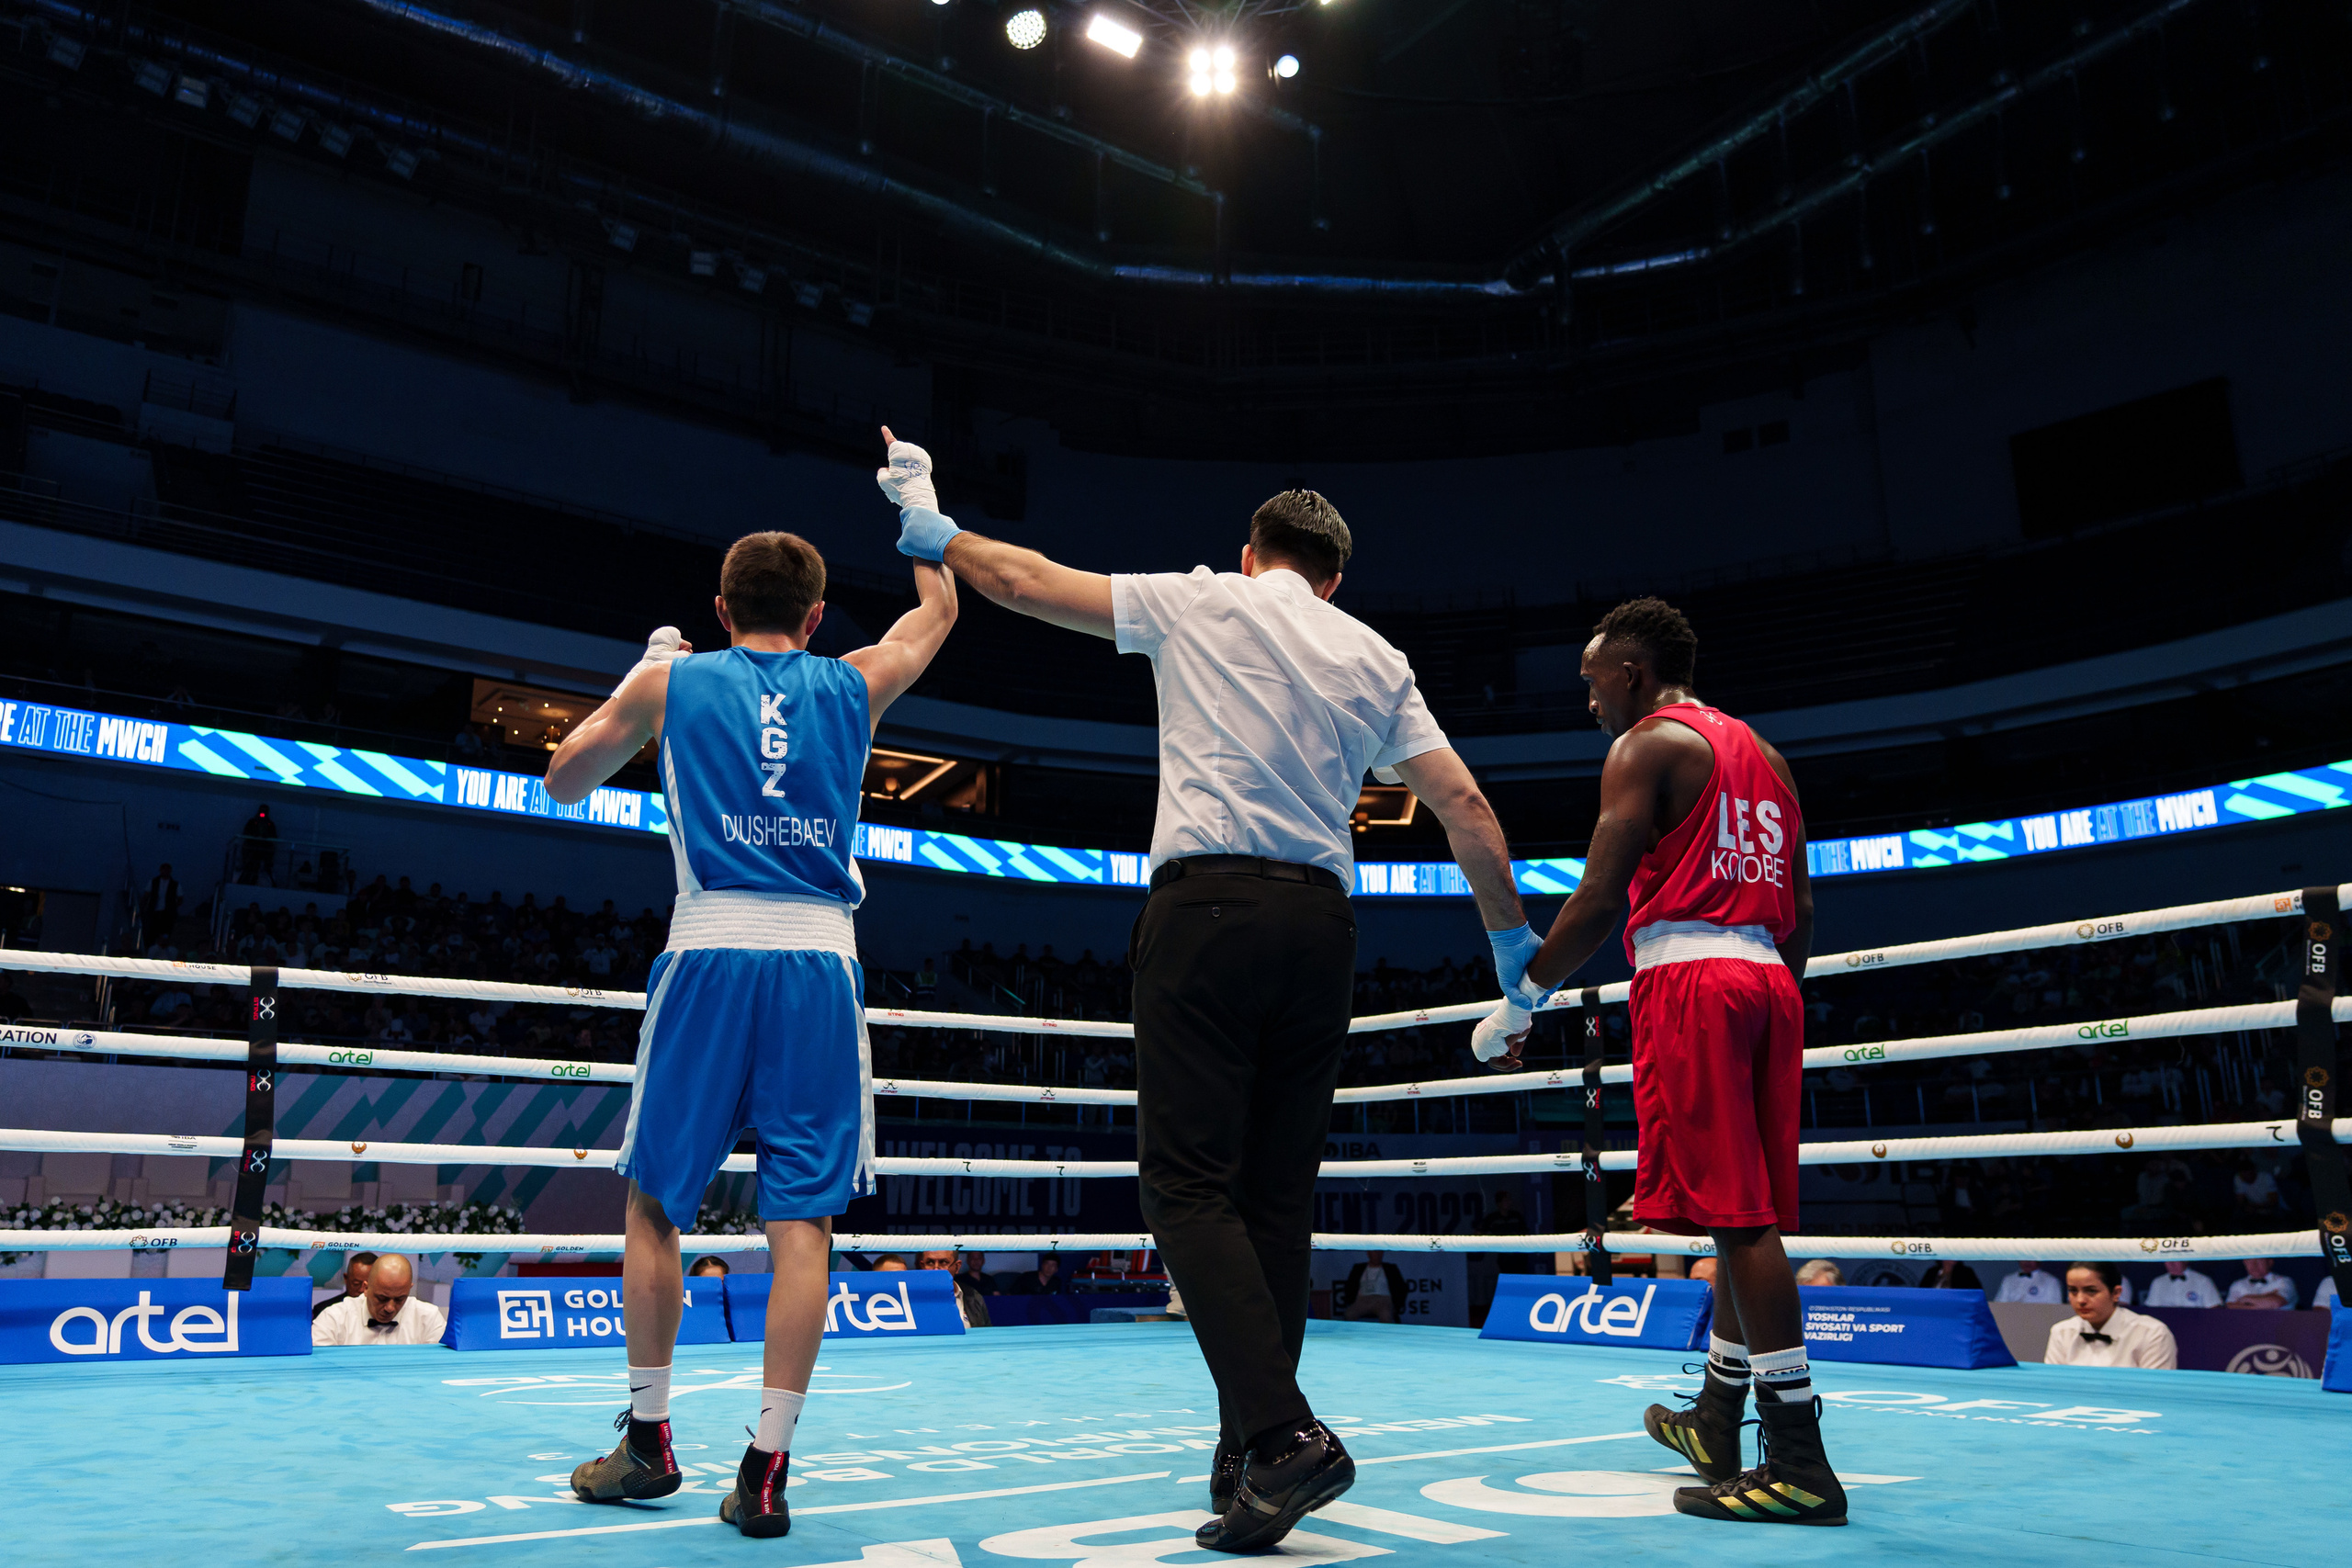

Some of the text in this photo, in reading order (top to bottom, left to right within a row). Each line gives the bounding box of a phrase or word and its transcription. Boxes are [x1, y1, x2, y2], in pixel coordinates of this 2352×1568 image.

[17, 705, 51, 747] AT
[53, 710, 96, 753] THE
[96, 716, 169, 764] MWCH
[760, 693, 788, 798] KGZ
[457, 768, 492, 807] YOU
[493, 774, 528, 812] ARE
[588, 787, 642, 828] MWCH
[1717, 791, 1784, 855] LES
[2020, 790, 2220, 852] YOU ARE AT THE MWCH
[868, 826, 913, 863] MWCH
[1819, 840, 1850, 874] THE
[1849, 835, 1905, 872] MWCH
[1109, 854, 1138, 885] YOU
[1359, 864, 1388, 894] YOU
[1390, 864, 1418, 894] ARE
[1419, 864, 1437, 894] AT
[1438, 864, 1466, 894] THE
[2098, 921, 2124, 934] OFB
[1862, 953, 1884, 964] OFB
[2311, 943, 2326, 974] OFB
[2077, 1020, 2130, 1041] artel
[329, 1050, 374, 1066] artel
[1844, 1043, 1886, 1063] artel
[551, 1063, 591, 1078] artel
[2308, 1089, 2324, 1120] OFB
[1341, 1142, 1382, 1158] IBA
[884, 1140, 1082, 1217] WELCOME TO
[151, 1238, 178, 1247] OFB
[231, 1231, 242, 1253] STG
[1703, 1244, 1716, 1253] OF
[1908, 1243, 1932, 1253] OFB
[2162, 1239, 2190, 1248] OFB
[2331, 1235, 2352, 1264] OFB
[564, 1289, 693, 1309] GOLN
[823, 1281, 918, 1333] rtel
[1529, 1283, 1657, 1337] artel
[49, 1291, 239, 1355] artel
[566, 1316, 626, 1337] HOU
[1804, 1322, 1905, 1334] SIYOSATI VA SPORT
[1807, 1313, 1855, 1323] YOSHLAR
[1804, 1331, 1854, 1342] VAZIRLIGI
[1818, 1390, 2164, 1425] OFB
[846, 1405, 1221, 1440] ASHKENT
[385, 1467, 896, 1517] BXNG
